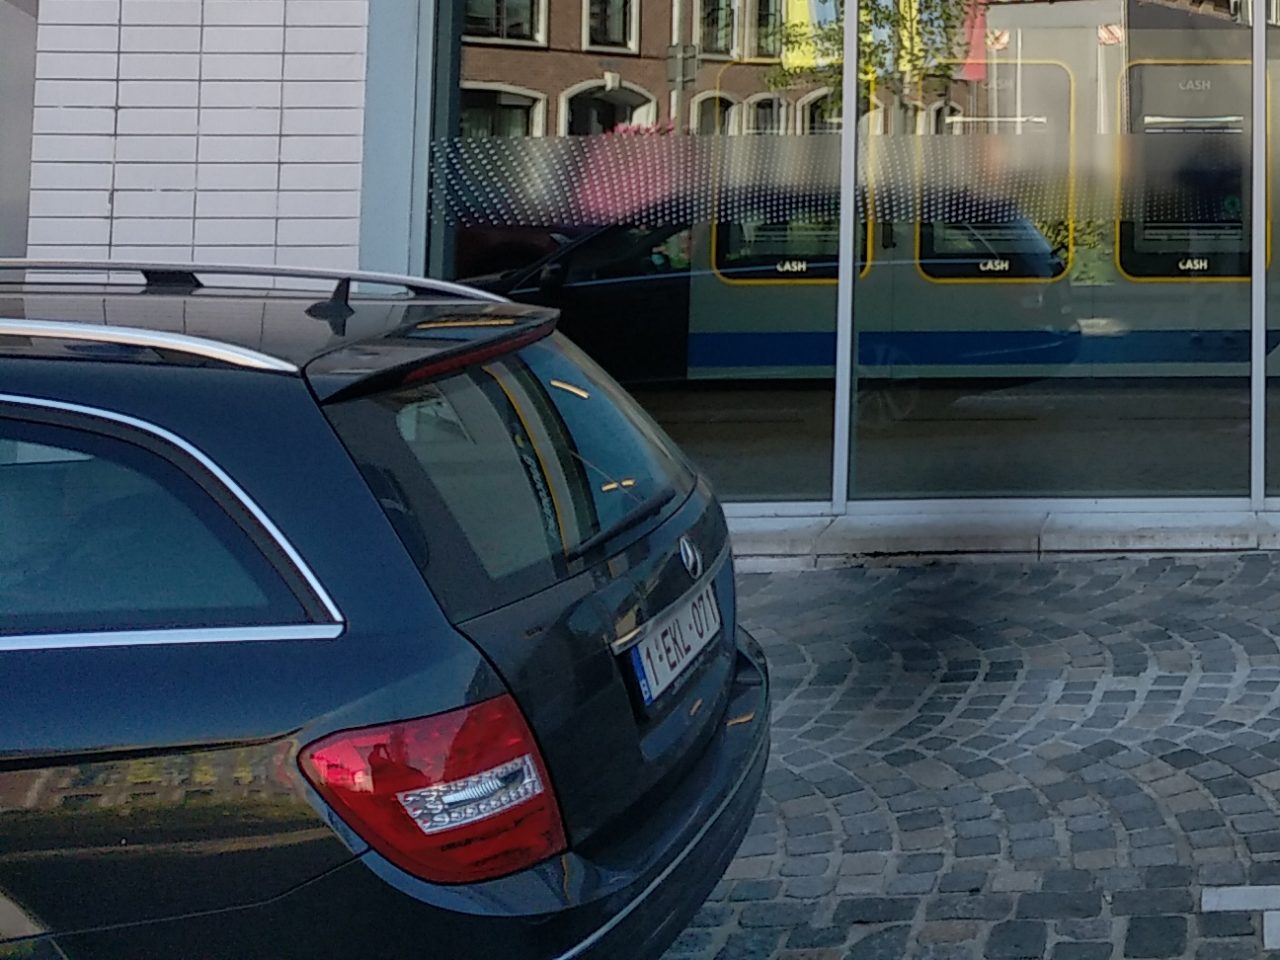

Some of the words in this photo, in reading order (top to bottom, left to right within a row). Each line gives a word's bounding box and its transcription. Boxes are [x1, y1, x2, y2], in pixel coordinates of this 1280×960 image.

[1179, 79, 1211, 90] CASH
[776, 260, 807, 272] CASH
[980, 259, 1009, 271] CASH
[1178, 259, 1208, 270] CASH
